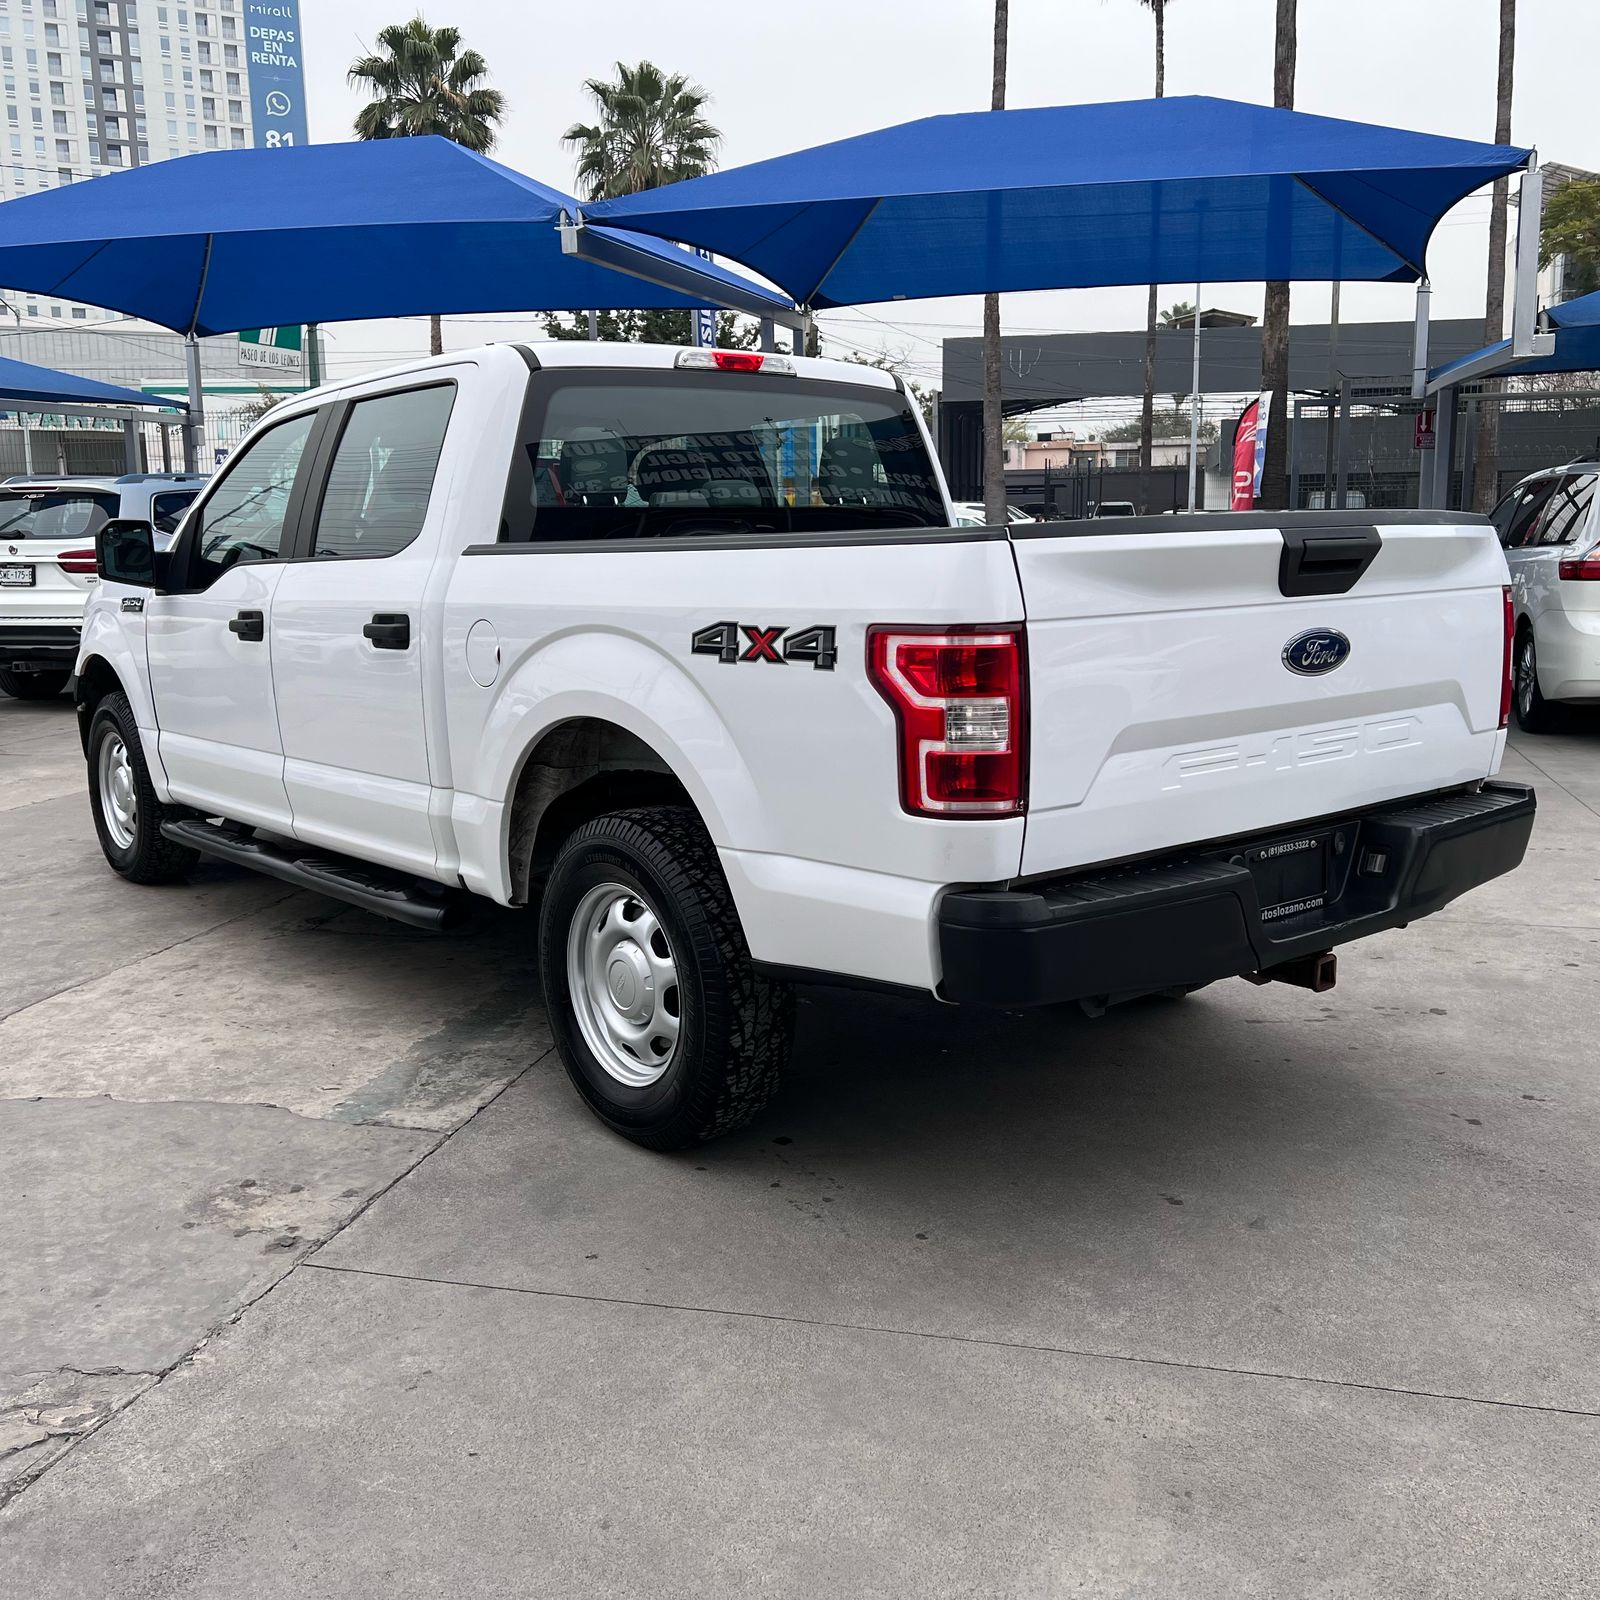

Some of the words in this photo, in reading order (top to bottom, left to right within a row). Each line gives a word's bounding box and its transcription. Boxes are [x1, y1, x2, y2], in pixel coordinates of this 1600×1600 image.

[250, 26, 295, 43] DEPAS
[263, 40, 283, 54] EN
[251, 51, 297, 68] RENTA
[265, 129, 294, 148] 81
[240, 347, 258, 362] PASEO
[260, 350, 267, 363] DE
[269, 351, 279, 365] LOS
[280, 353, 300, 367] LEONES
[1301, 638, 1339, 666] Ford
[1161, 714, 1424, 792] F-150
